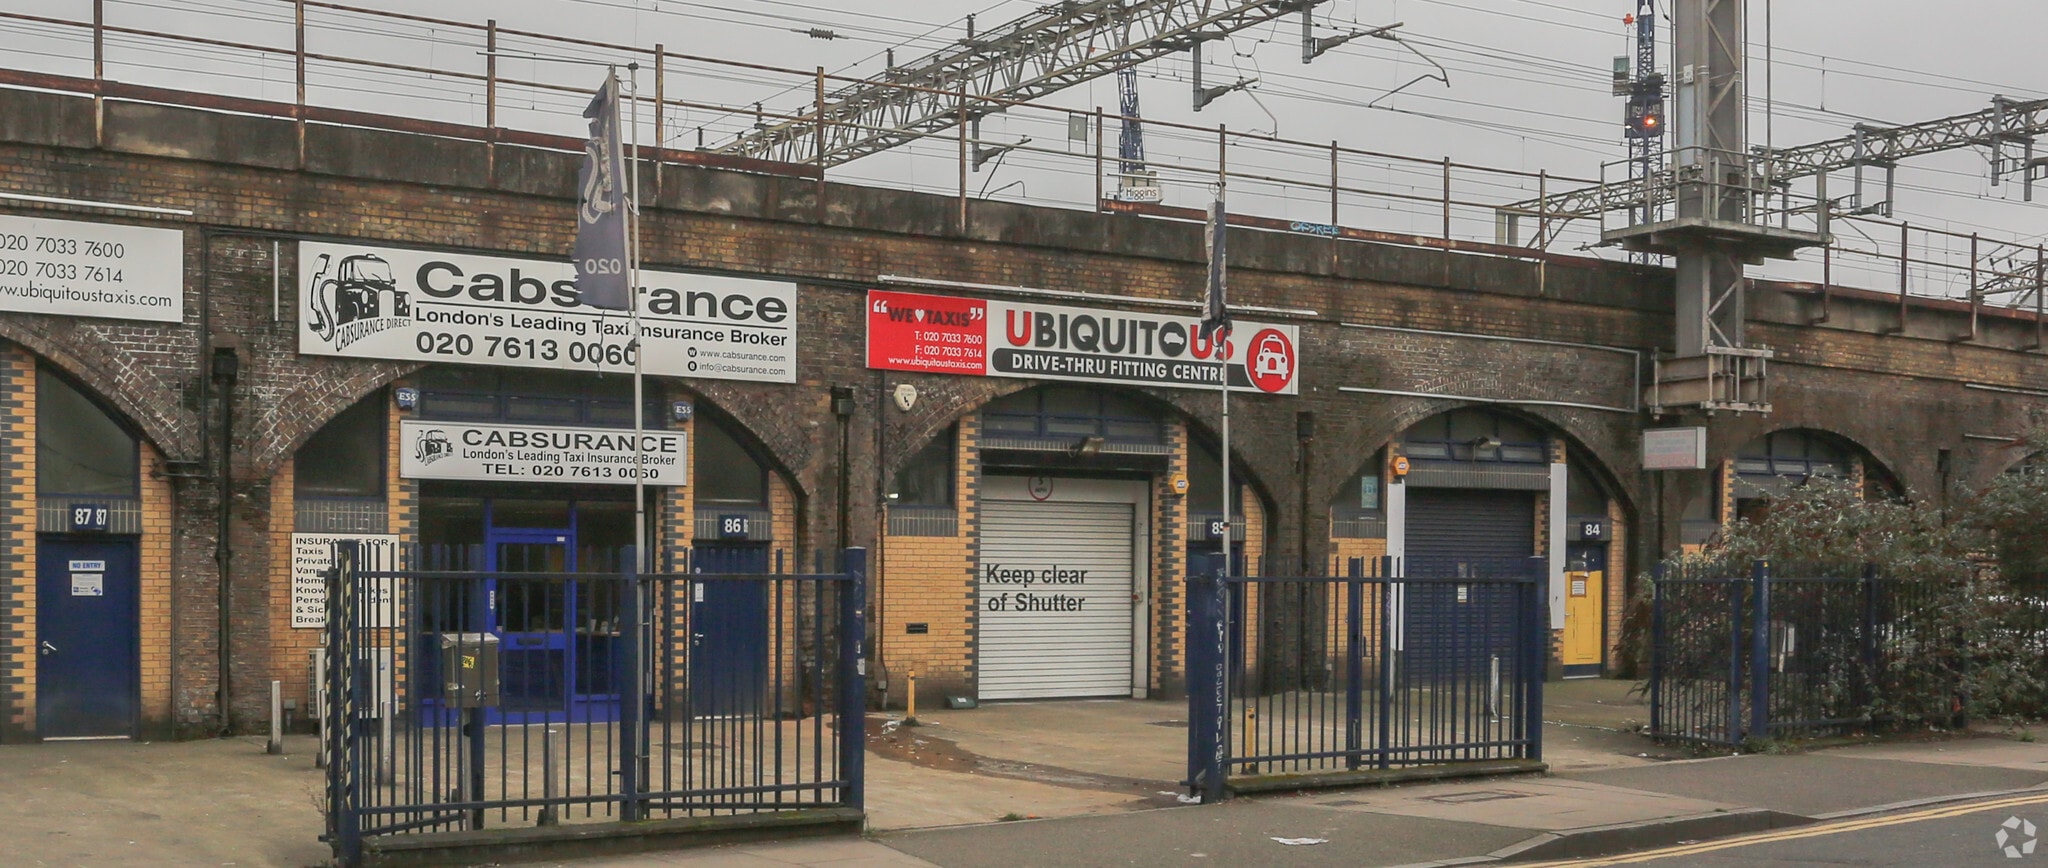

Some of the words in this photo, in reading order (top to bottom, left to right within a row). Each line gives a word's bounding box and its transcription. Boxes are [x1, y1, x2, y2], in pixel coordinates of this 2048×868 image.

[1126, 187, 1157, 200] Higgins
[35, 236, 77, 255] 7033
[84, 240, 124, 258] 7600
[35, 262, 77, 280] 7033
[84, 265, 123, 283] 7614
[0, 280, 172, 307] w.ubiquitoustaxis.com
[416, 260, 788, 323] Cabsrance
[415, 307, 504, 327] London's
[511, 313, 586, 335] Leading
[592, 319, 629, 336] Taxi
[637, 323, 725, 342] nsurance
[730, 329, 787, 346] Broker
[335, 318, 384, 352] CABSURANCE
[386, 318, 411, 330] DIRECT
[914, 330, 922, 341] T:
[923, 331, 939, 342] 020
[942, 332, 961, 343] 7033
[964, 334, 983, 345] 7600
[1006, 309, 1234, 361] UBIQUITOUS
[416, 331, 474, 356] 020
[484, 335, 559, 361] 7613
[915, 344, 922, 354] F:
[924, 345, 940, 355] 020
[943, 346, 961, 357] 7033
[964, 348, 983, 358] 7614
[700, 351, 786, 362] www.cabsurance.com
[888, 355, 983, 369] www.ubiquitoustaxis.com
[699, 362, 786, 375] info@cabsurance.com
[1012, 353, 1106, 375] DRIVE-THRU
[1110, 359, 1167, 378] FITTING
[399, 392, 417, 402] ESS
[675, 405, 692, 414] ESS
[462, 429, 677, 453] CABSURANCE
[517, 449, 560, 464] Leading
[563, 451, 584, 463] Taxi
[587, 452, 637, 465] Insurance
[641, 454, 676, 465] Broker
[482, 463, 525, 476] TEL:
[532, 465, 564, 477] 020
[570, 466, 612, 478] 7613
[618, 467, 659, 479] 0060
[75, 508, 91, 525] 87
[96, 509, 107, 525] 87
[724, 518, 741, 533] 86
[1585, 524, 1600, 536] 84
[295, 537, 362, 545] INSURA
[296, 547, 324, 555] Taxis
[985, 563, 1034, 588] Keep
[1041, 564, 1088, 584] clear
[987, 592, 1008, 612] of
[1014, 592, 1086, 612] Shutter
